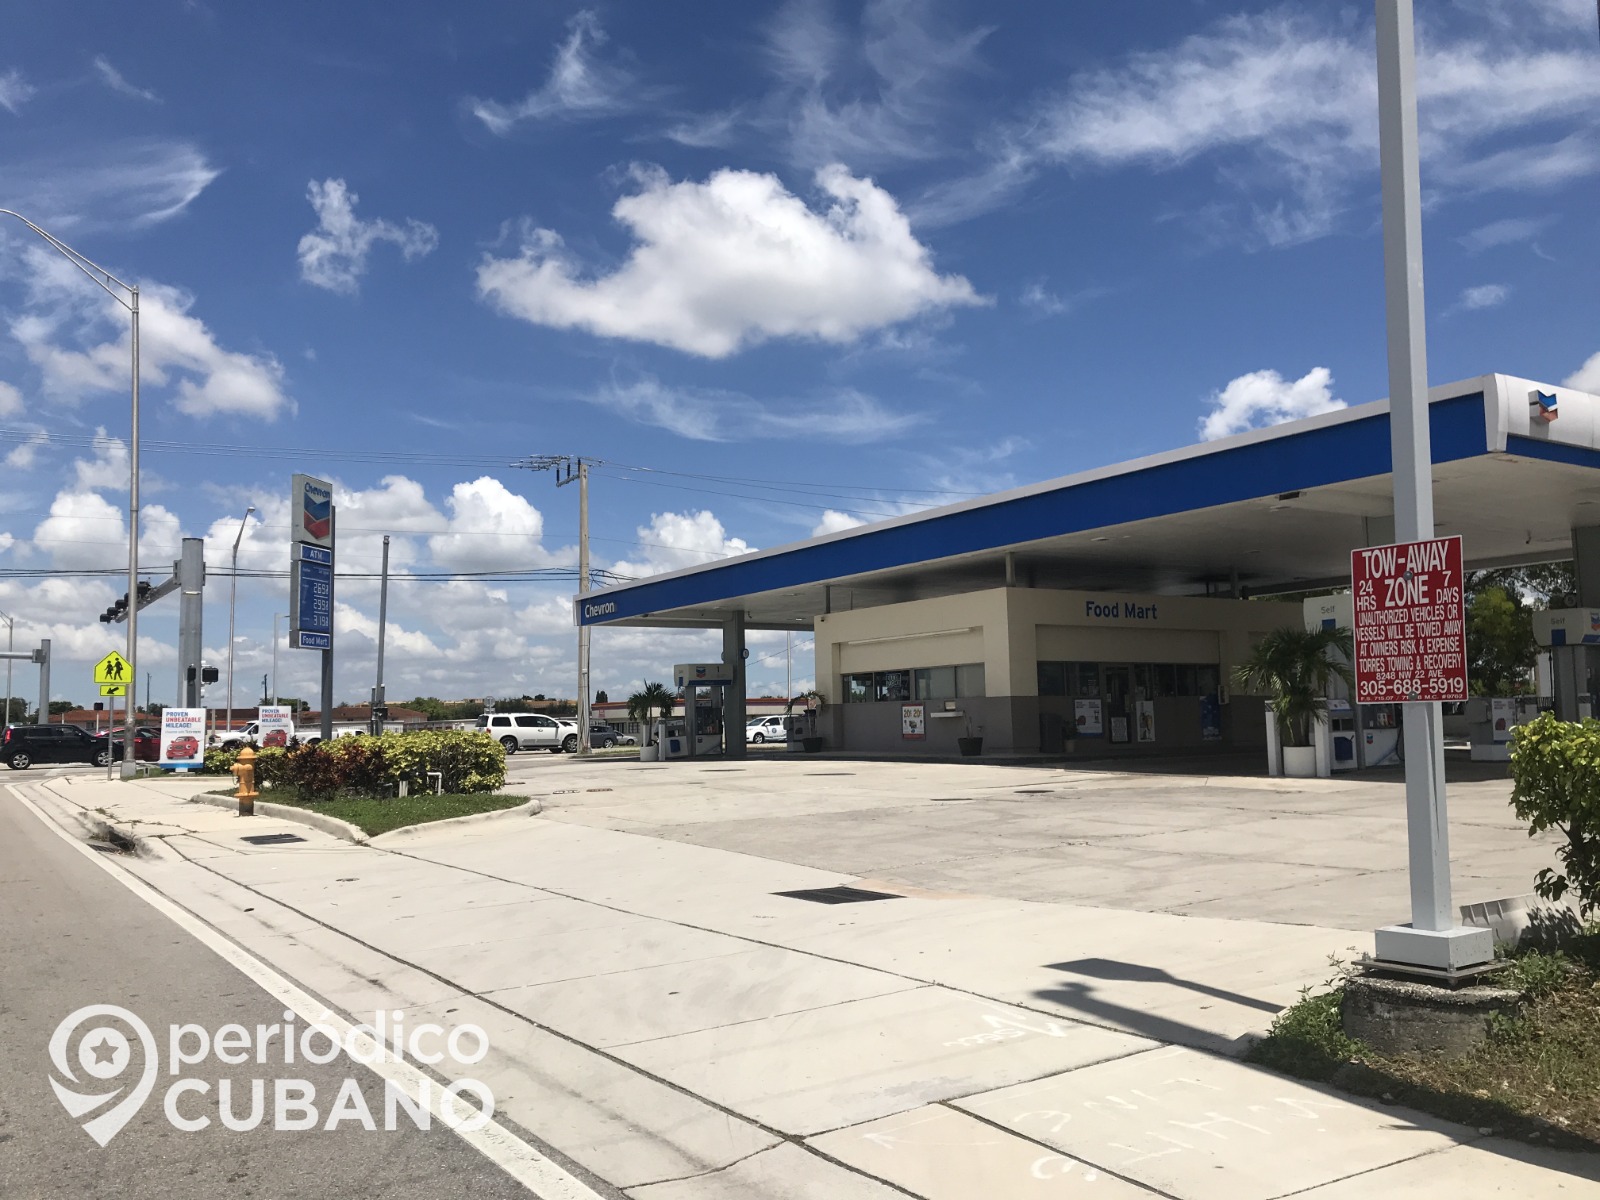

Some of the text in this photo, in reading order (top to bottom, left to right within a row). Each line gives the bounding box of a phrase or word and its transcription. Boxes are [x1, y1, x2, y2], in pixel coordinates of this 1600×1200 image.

[304, 482, 330, 498] Chevron
[310, 550, 322, 560] ATM
[1362, 541, 1448, 578] TOW-AWAY
[1442, 571, 1451, 586] 7
[1359, 580, 1373, 595] 24
[1385, 575, 1429, 607] ZONE
[1436, 588, 1459, 604] DAYS
[584, 601, 615, 619] Chevron
[1087, 602, 1157, 619] Food Mart
[1357, 595, 1376, 611] HRS
[1359, 605, 1457, 626] UNAUTHORIZED VEHICLES OR
[1356, 620, 1461, 641] VESSELS WILL BE TOWED AWAY
[303, 636, 314, 644] Food
[1360, 637, 1460, 656] AT OWNERS RISK & EXPENSE
[1359, 654, 1461, 672] TORRES TOWING & RECOVERY
[1376, 672, 1395, 680] 8248
[1399, 671, 1412, 679] NW
[1428, 670, 1445, 678] AVE.
[1361, 677, 1463, 695] 305-688-5919
